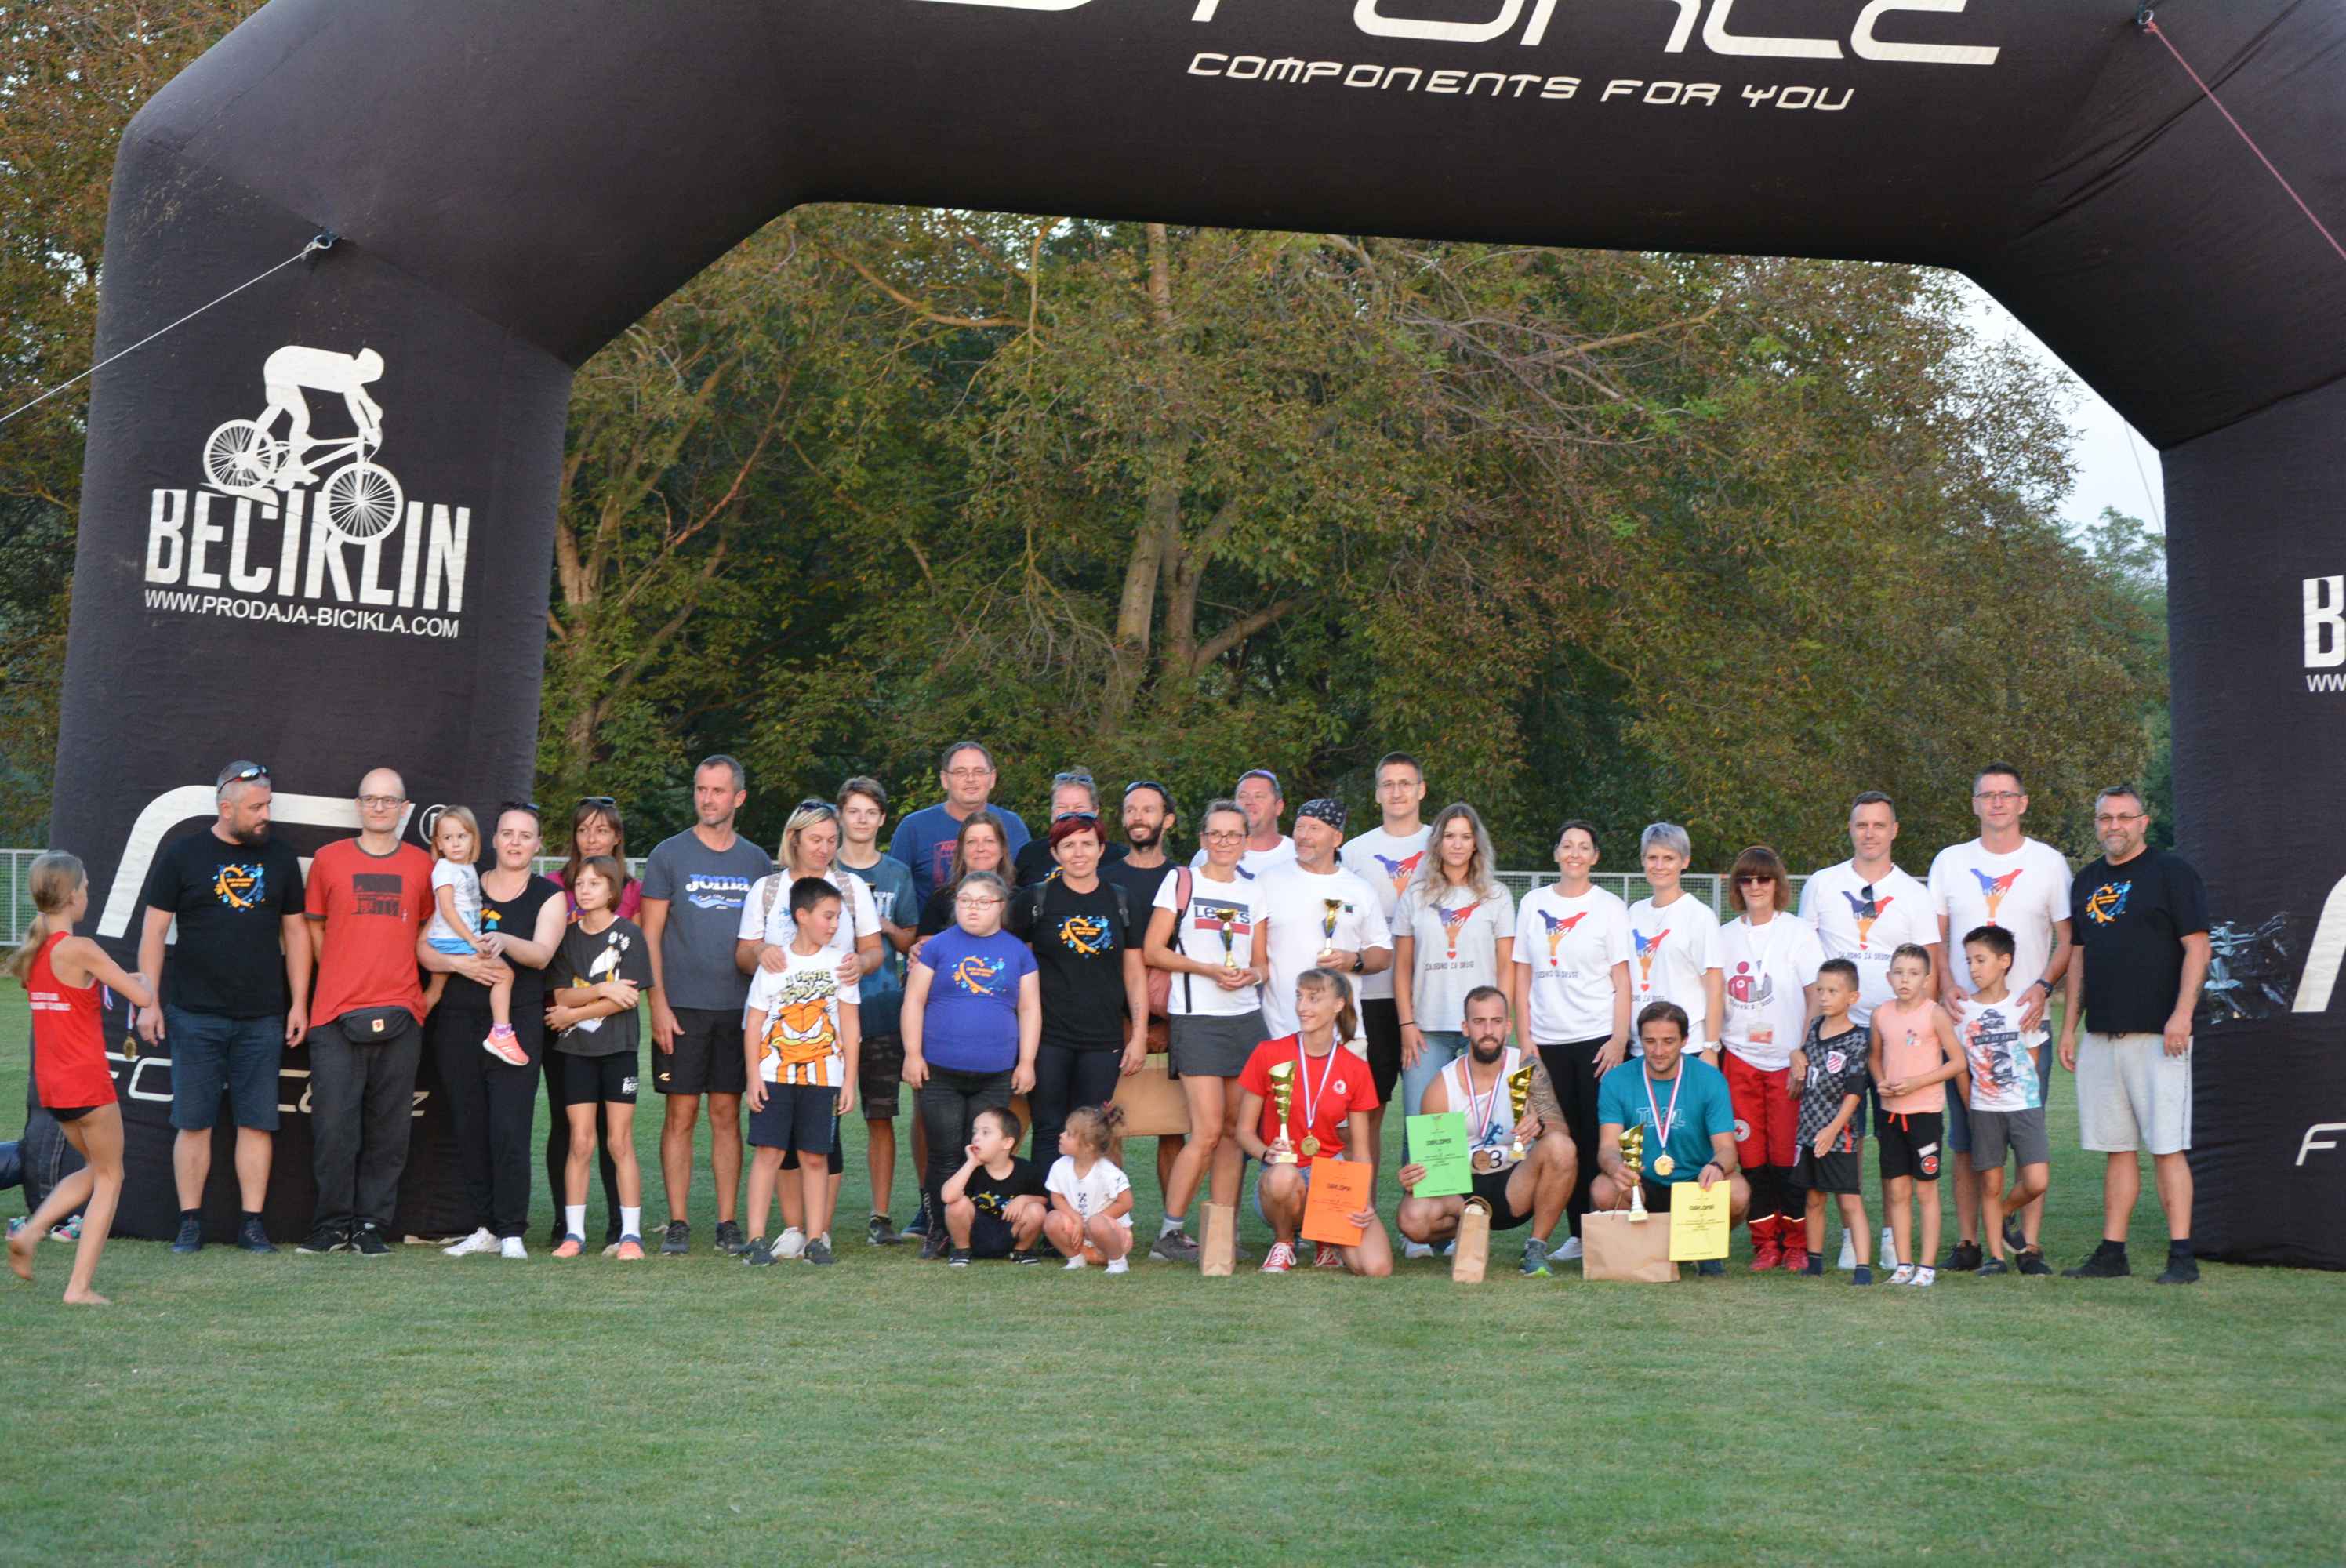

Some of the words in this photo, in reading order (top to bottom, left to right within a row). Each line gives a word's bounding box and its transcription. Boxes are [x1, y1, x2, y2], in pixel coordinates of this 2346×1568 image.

[1187, 53, 1581, 100] COMPONENTS
[1600, 80, 1721, 107] FOR
[1741, 85, 1854, 111] YOU
[144, 589, 459, 639] WWW.PRODAJA-BICIKLA.COM
